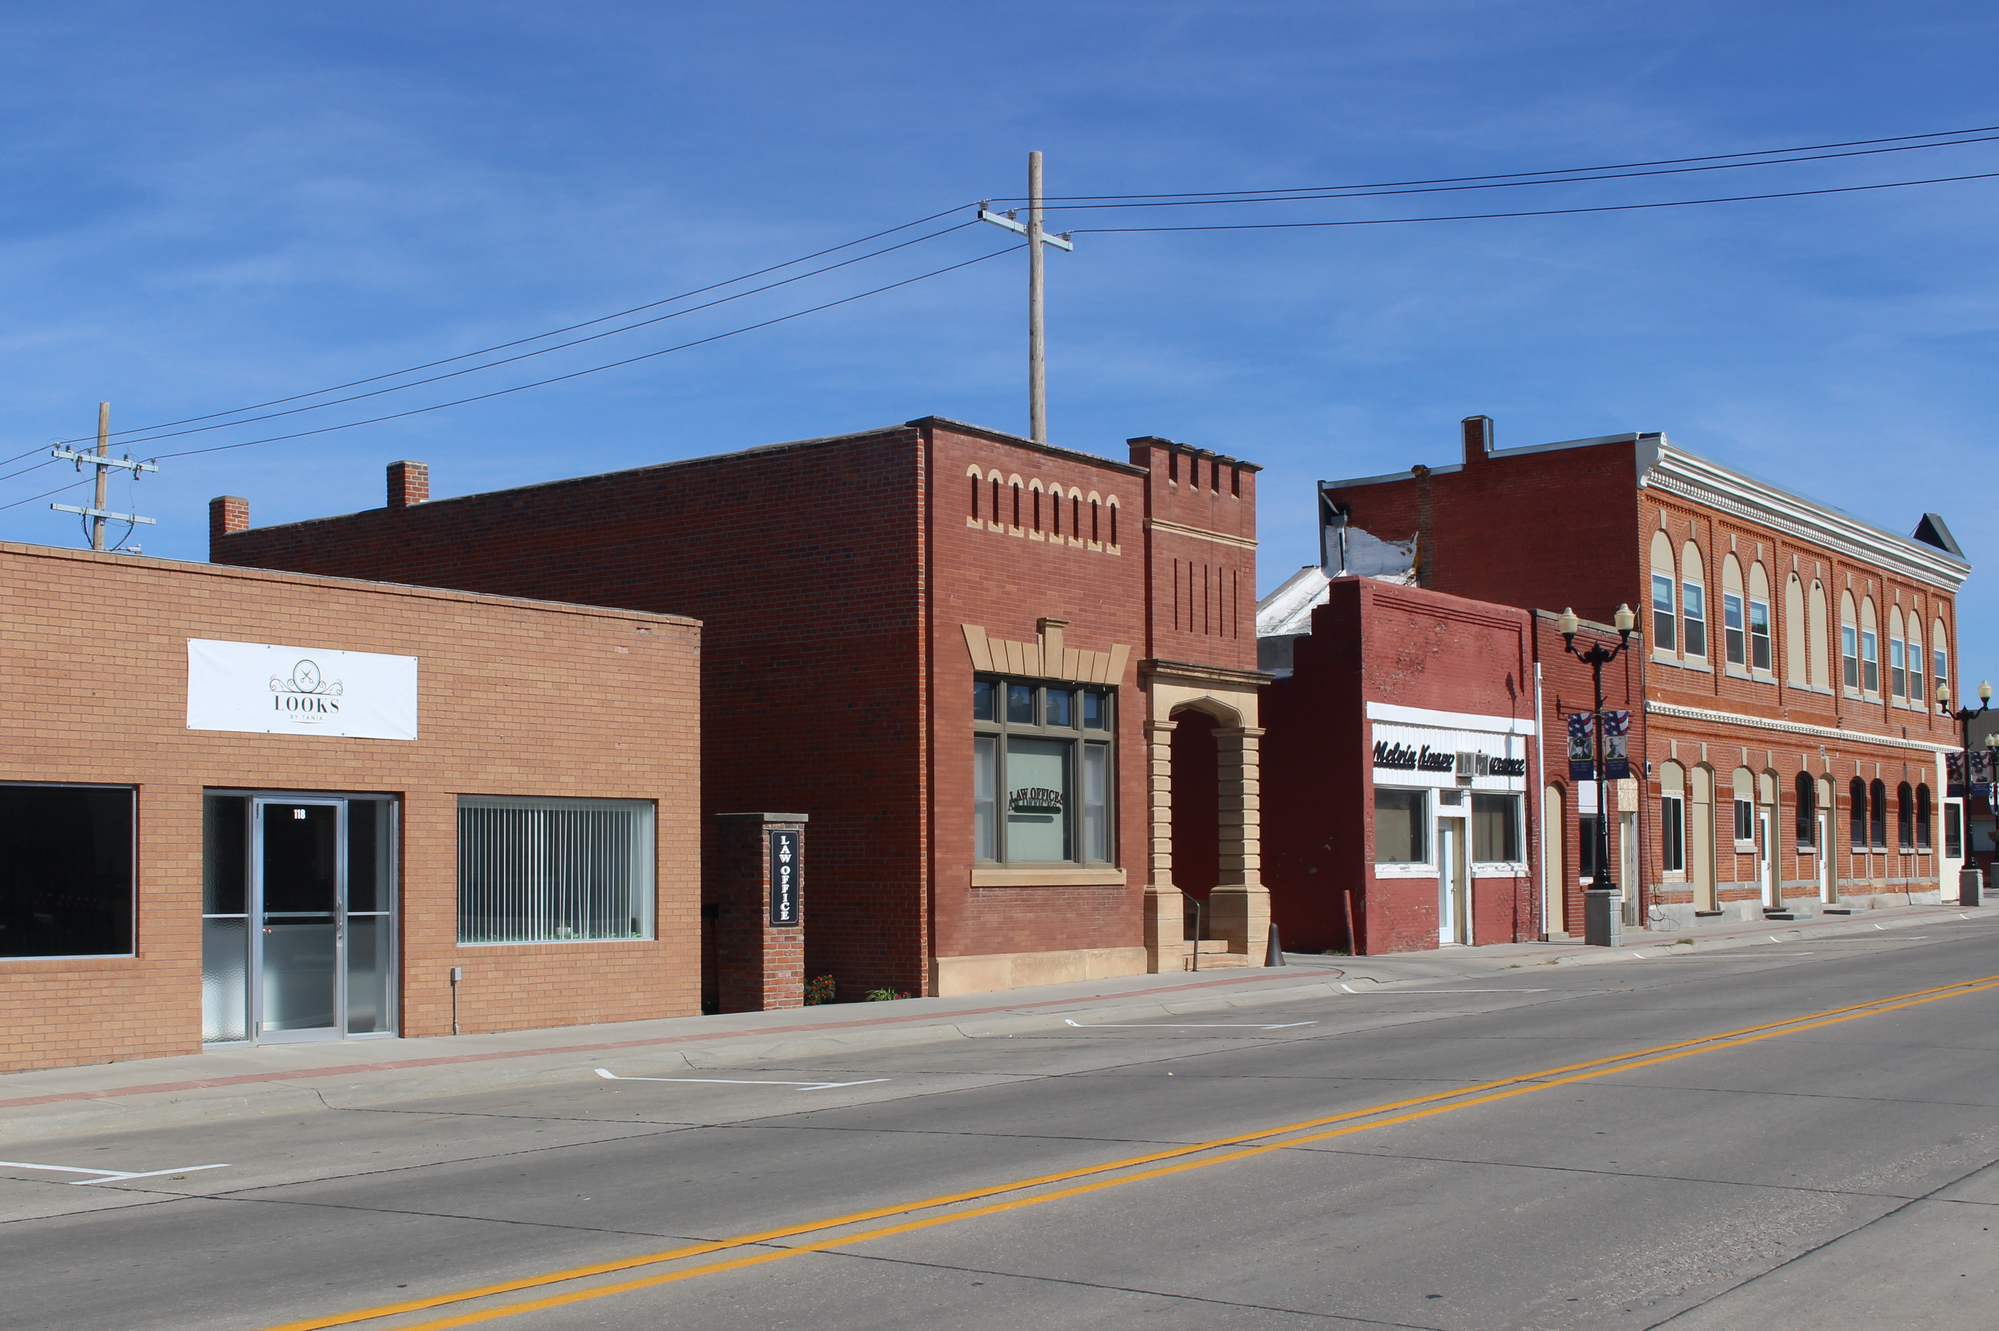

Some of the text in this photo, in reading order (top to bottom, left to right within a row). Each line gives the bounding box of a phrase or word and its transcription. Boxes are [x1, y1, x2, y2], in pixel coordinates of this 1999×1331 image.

[274, 695, 339, 714] LOOKS
[1373, 740, 1416, 770] Melvin
[1009, 787, 1064, 805] LAW OFFICES
[293, 808, 306, 820] 118
[779, 835, 792, 920] LAW OFFICE
